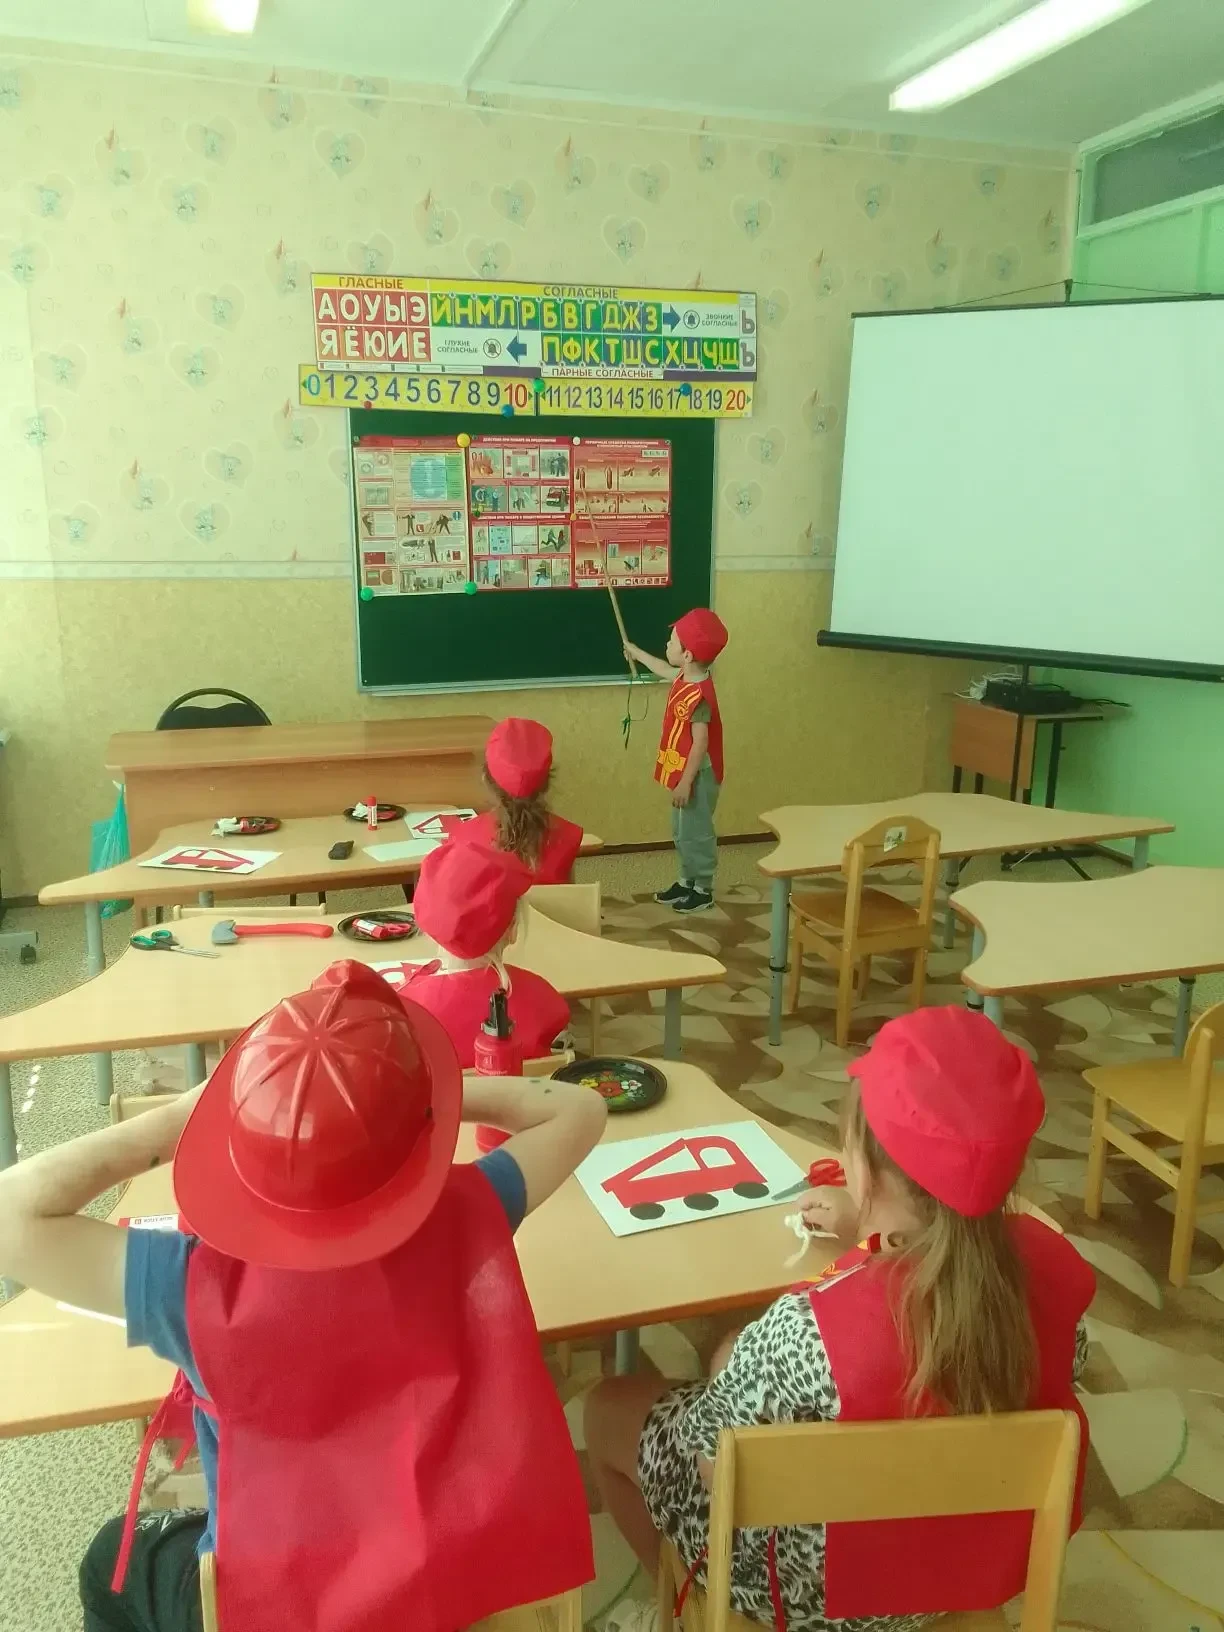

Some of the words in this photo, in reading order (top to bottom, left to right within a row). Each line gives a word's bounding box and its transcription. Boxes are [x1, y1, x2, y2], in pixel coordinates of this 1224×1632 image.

[338, 277, 404, 289] ГЛАСНЫЕ
[543, 286, 618, 298] СОГЛАСНЫЕ
[436, 346, 478, 354] СОГЛАСНЫЕ
[552, 368, 593, 378] ПАРНЫЕ
[595, 369, 653, 378] СОГЛАСНЫЕ
[307, 374, 321, 396] 0
[325, 374, 335, 398] 1
[344, 375, 358, 399] 2
[364, 375, 379, 400] 3
[385, 377, 400, 401] 4
[406, 378, 420, 402] 5
[427, 379, 442, 403] 6
[448, 380, 462, 404] 7
[468, 381, 481, 406] 8
[487, 382, 500, 407] 9
[504, 383, 528, 408] 10
[546, 386, 562, 408] 11
[565, 386, 582, 408] 12
[585, 387, 602, 409] 13
[606, 387, 624, 409] 14
[627, 388, 644, 410] 15
[647, 388, 664, 410] 16
[667, 389, 682, 410] 17
[688, 389, 702, 411] 18
[705, 389, 722, 411] 19
[726, 390, 746, 411] 20
